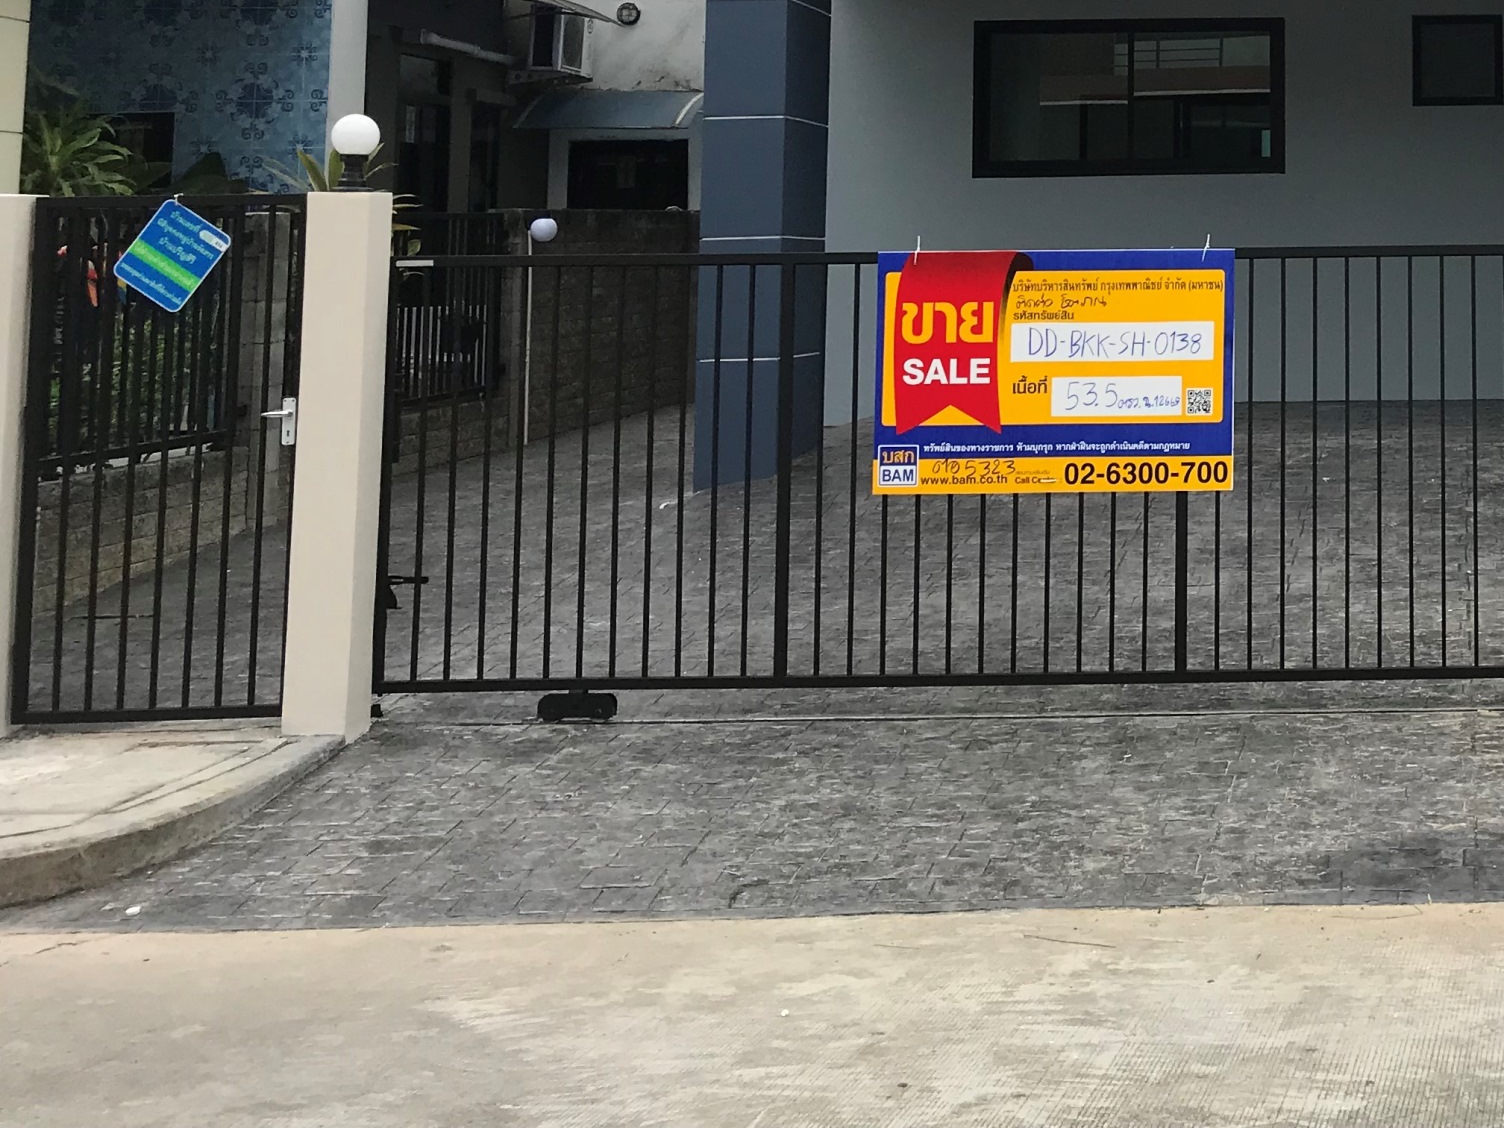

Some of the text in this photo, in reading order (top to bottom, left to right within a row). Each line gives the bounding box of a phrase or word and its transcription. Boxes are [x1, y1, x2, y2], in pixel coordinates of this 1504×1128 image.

[1012, 277, 1223, 295] บริษัทบริหารสินทรัพย์ กรุงเทพพาณิชย์ จำกัด (มหาชน)
[901, 301, 994, 345] ขาย
[1013, 309, 1075, 321] รหัสทรัพย์สิน
[902, 358, 991, 385] SALE
[1012, 376, 1048, 395] เนื้อที่
[882, 450, 914, 464] บสก
[882, 469, 914, 482] BAM
[921, 474, 1008, 485] www.bam.co.th
[1015, 476, 1030, 484] Call
[1064, 461, 1228, 485] 02-6300-700
